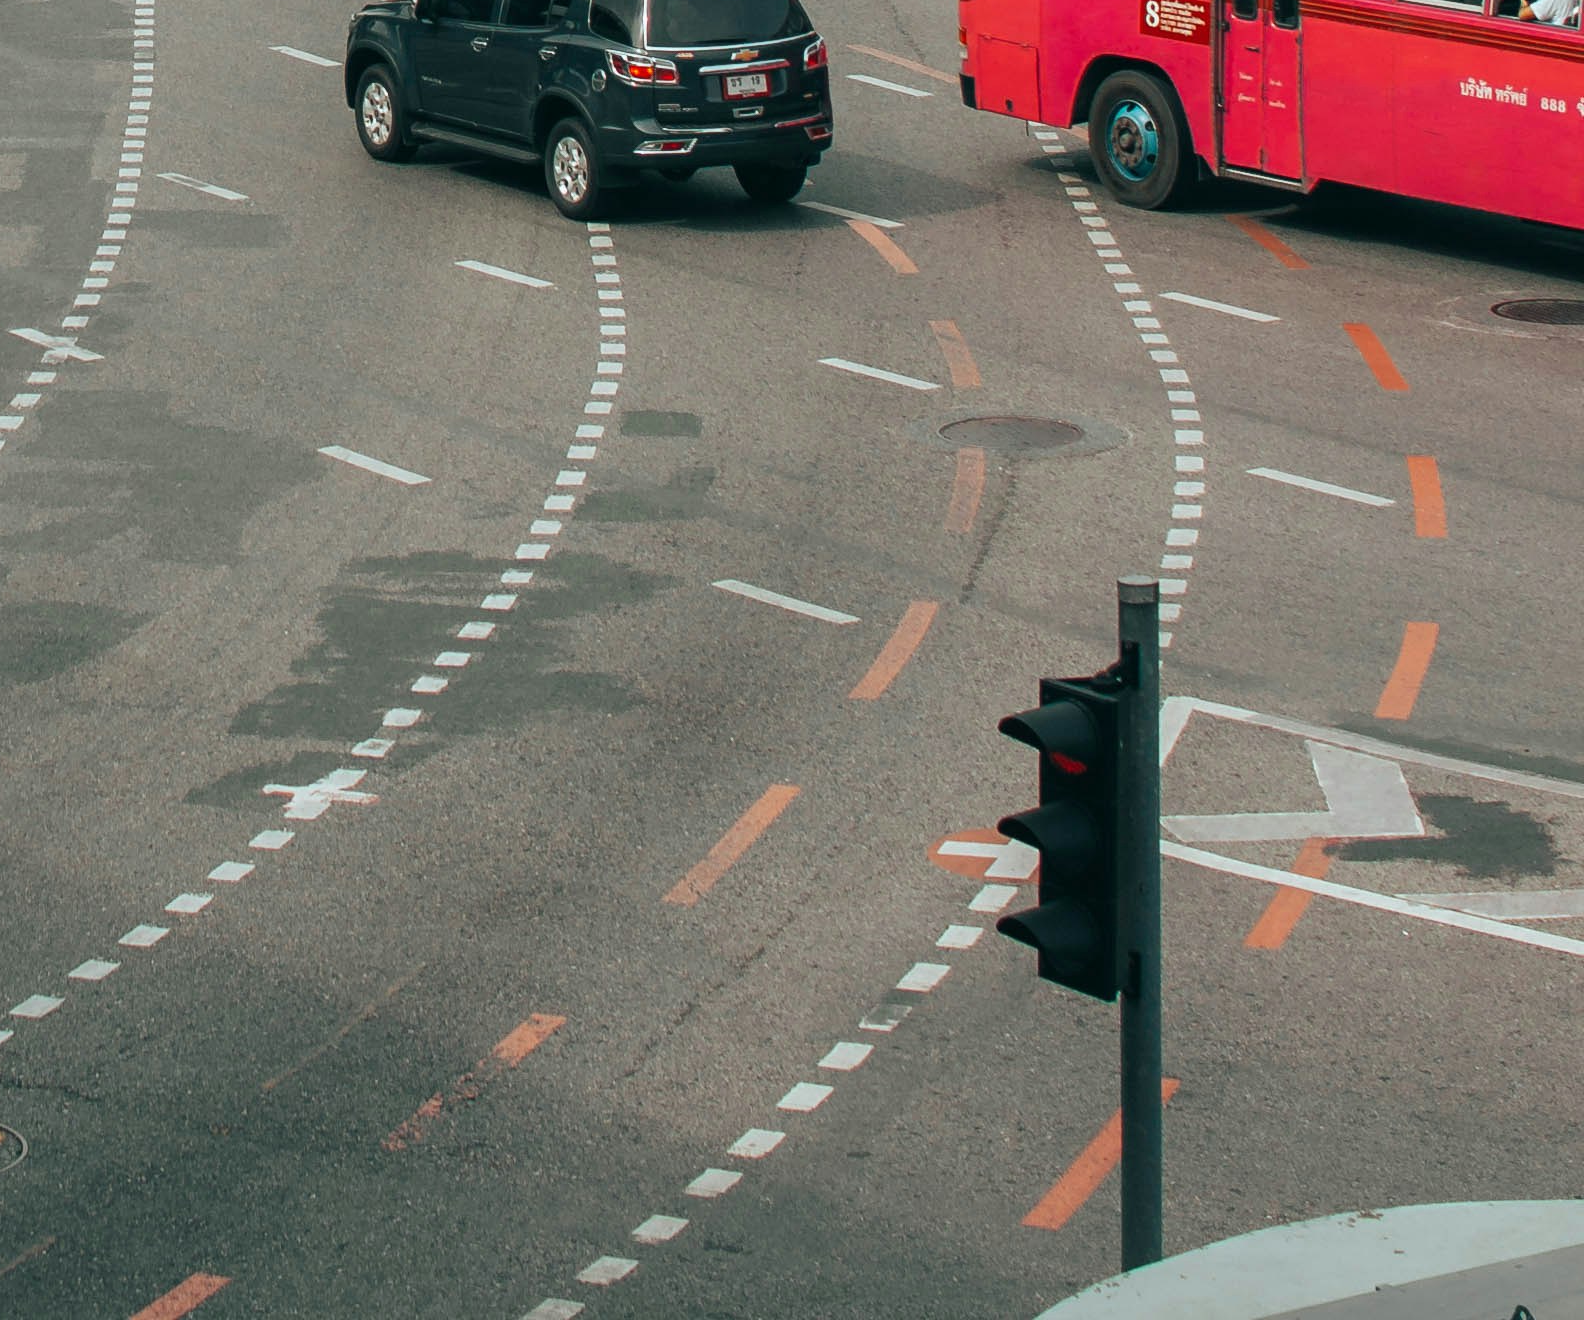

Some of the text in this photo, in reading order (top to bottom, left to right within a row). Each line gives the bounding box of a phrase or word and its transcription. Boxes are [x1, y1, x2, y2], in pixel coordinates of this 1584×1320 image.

[1145, 0, 1160, 28] 8
[1459, 77, 1493, 100] บริษัท
[1495, 84, 1529, 107] ทรัพย์
[1540, 97, 1567, 113] 888
